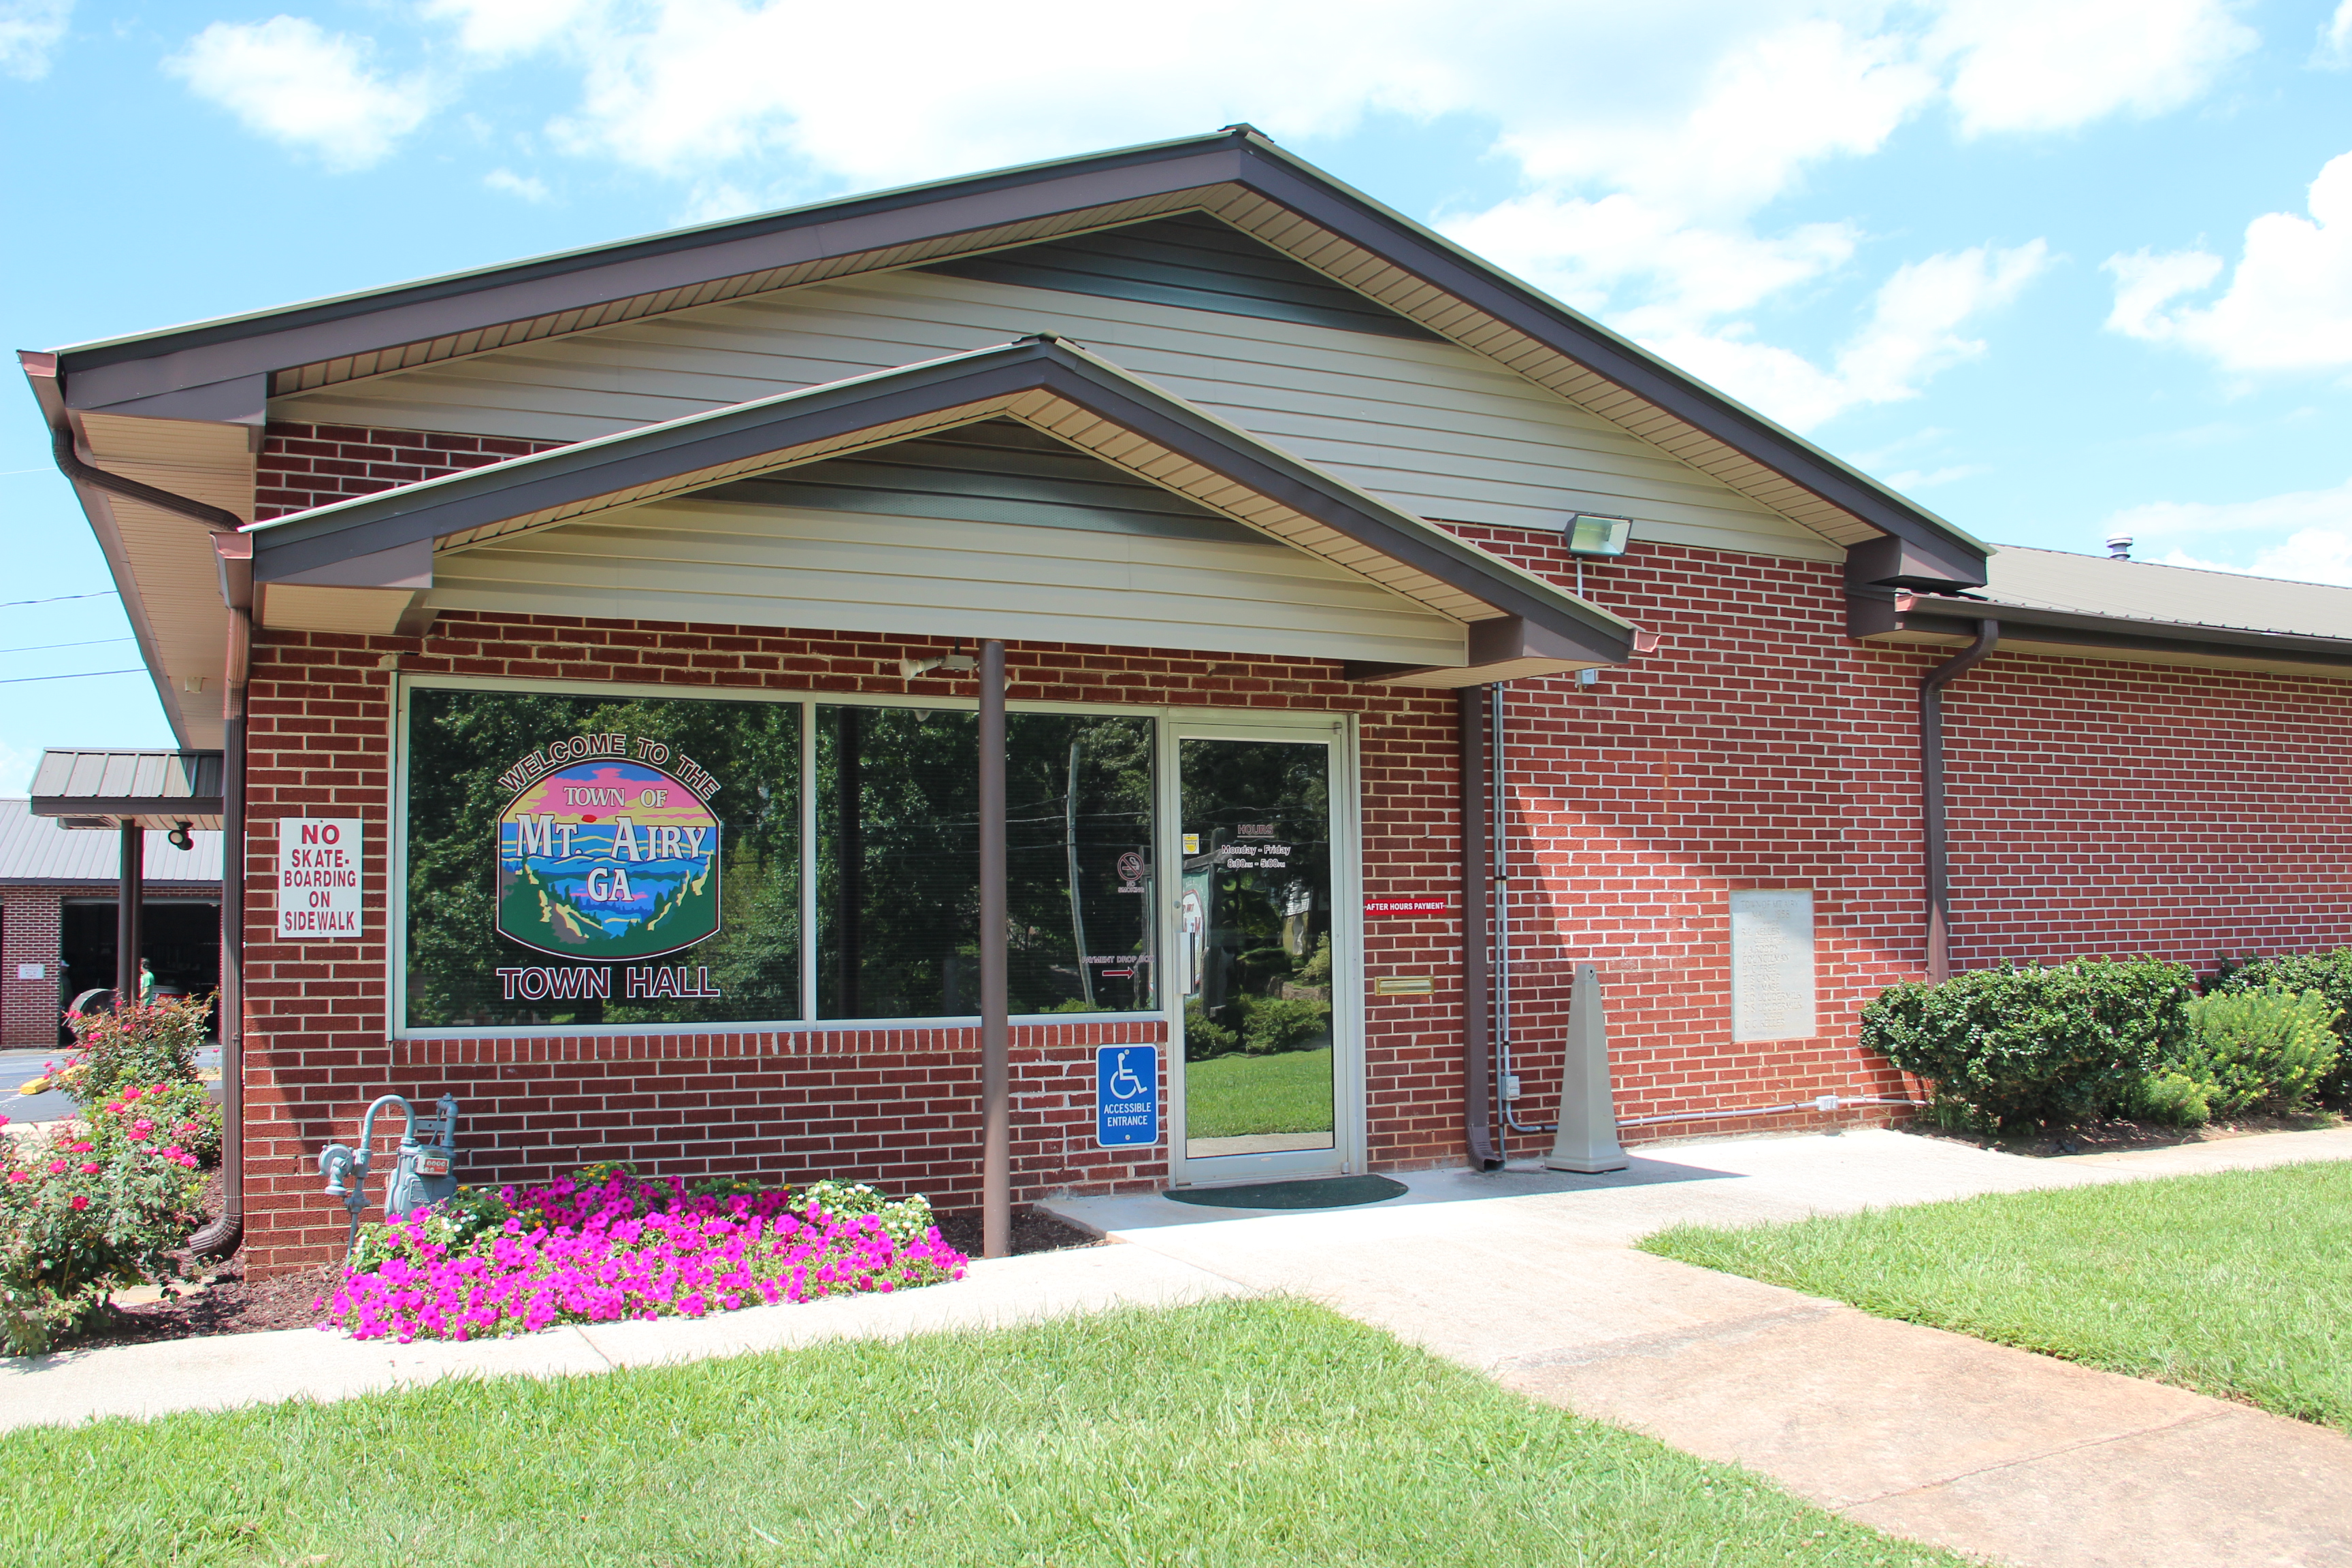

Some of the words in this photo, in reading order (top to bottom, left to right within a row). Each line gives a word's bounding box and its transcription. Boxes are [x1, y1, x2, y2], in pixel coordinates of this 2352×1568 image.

[497, 734, 626, 794] WELCOME
[637, 737, 669, 764] TO
[676, 754, 721, 800] THE
[564, 787, 625, 806] TOWN
[640, 788, 668, 807] OF
[301, 825, 340, 845] NO
[1237, 824, 1273, 834] HOURS
[611, 816, 708, 862] AIRY
[1222, 845, 1257, 855] Monday
[1264, 845, 1291, 855] Friday
[284, 870, 357, 887] BOARDING
[587, 867, 634, 902] GA
[309, 891, 331, 907] ON
[1390, 902, 1413, 911] HOURS
[1414, 902, 1443, 910] PAYMENT
[284, 911, 355, 931] SIDEWALK
[1082, 956, 1115, 964] PAYMENT
[1139, 955, 1155, 963] BOX
[496, 966, 610, 1000] TOWN
[626, 966, 721, 998] HALL
[1104, 1102, 1152, 1114] ACCESSIBLE
[1107, 1115, 1148, 1127] ENTRANCE
